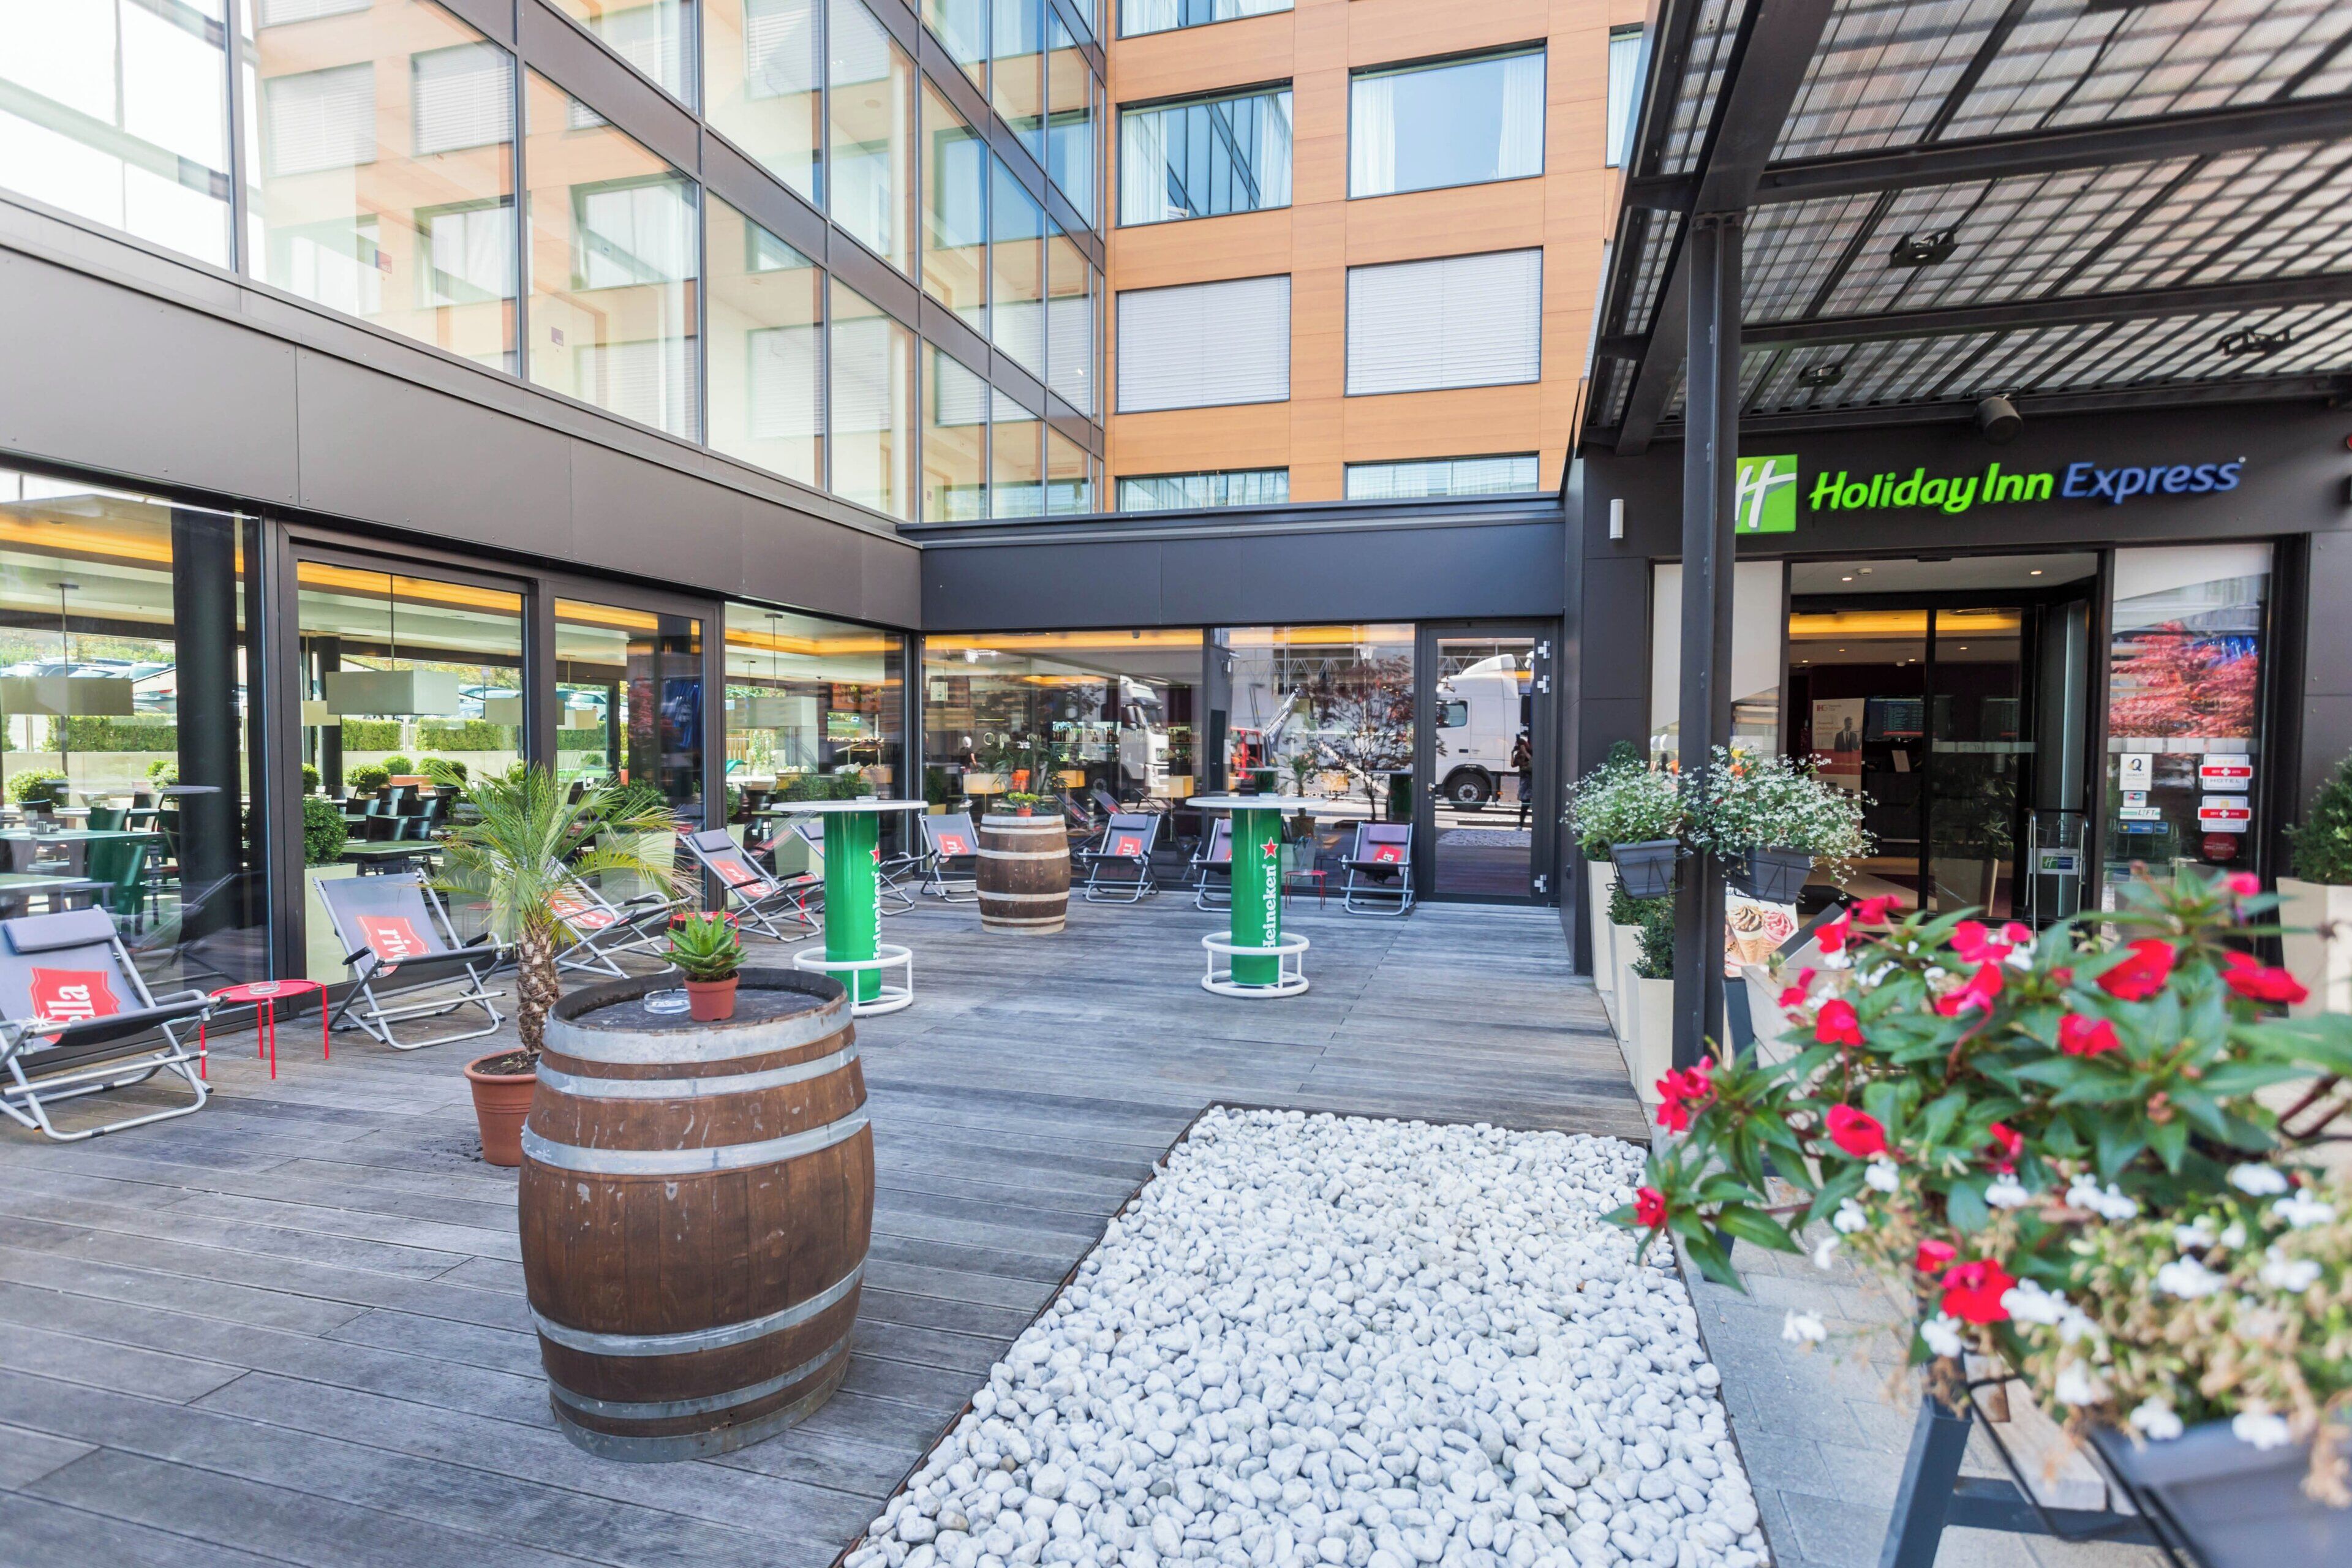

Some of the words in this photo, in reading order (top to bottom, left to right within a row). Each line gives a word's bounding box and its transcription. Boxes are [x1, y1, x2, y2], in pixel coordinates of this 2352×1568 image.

[1809, 467, 1979, 513] Holiday
[1981, 462, 2054, 502] Inn
[2062, 461, 2243, 503] Express
